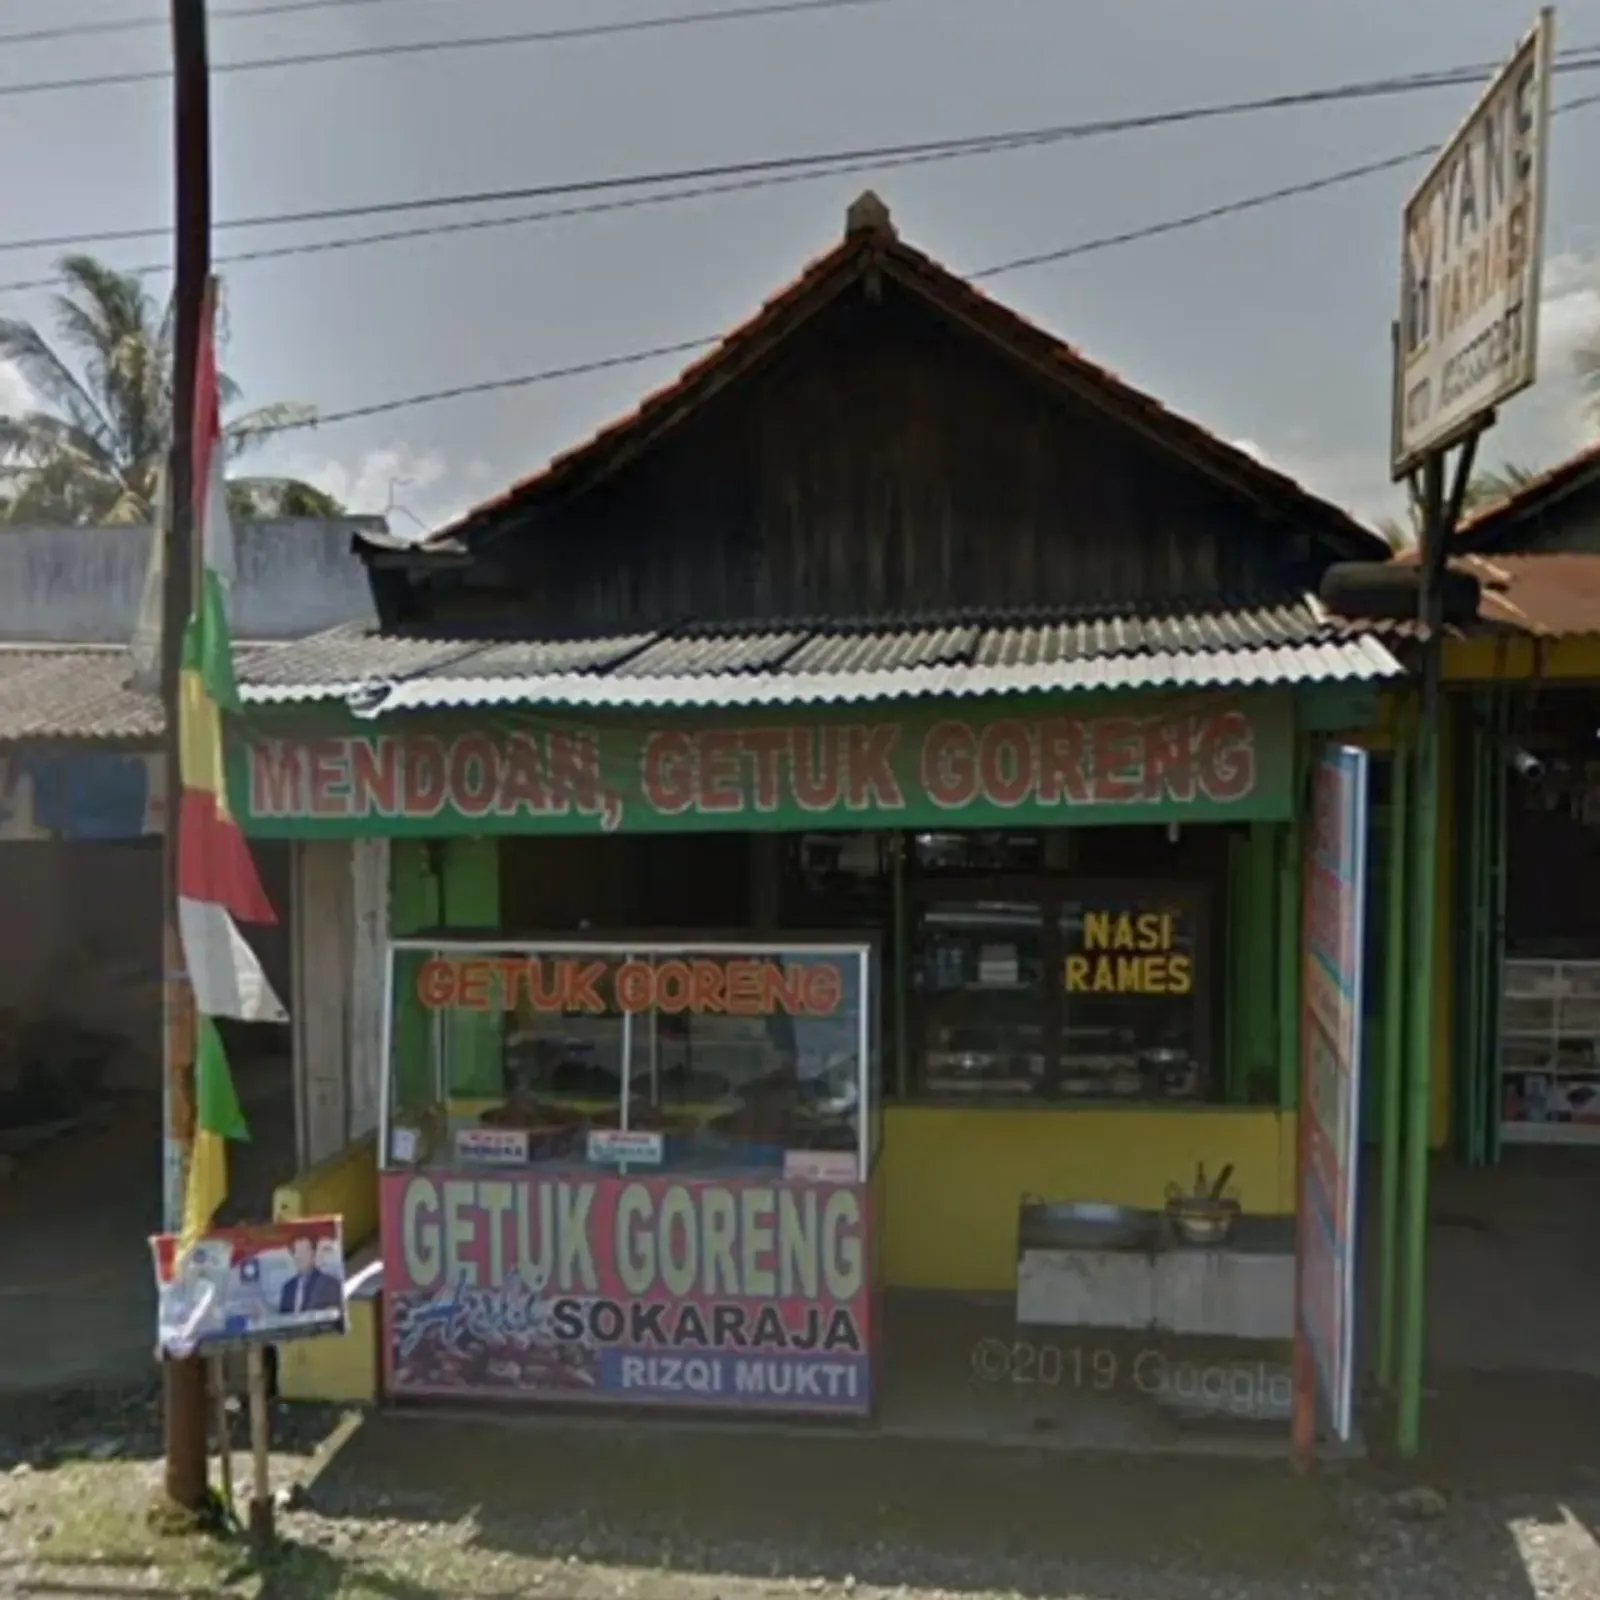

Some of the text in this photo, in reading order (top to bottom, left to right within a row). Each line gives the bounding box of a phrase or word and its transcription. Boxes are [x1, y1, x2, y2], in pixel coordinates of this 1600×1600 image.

[247, 711, 1256, 831] MENDOAN, GETUK GORENG
[1084, 912, 1172, 951] NASI
[417, 957, 841, 1015] GETUK GORENG
[1065, 955, 1192, 994] RAMES
[403, 1176, 864, 1299] GETUK GORENG
[553, 1298, 861, 1352] SOKARAJA
[621, 1355, 858, 1398] RIZQI MUKTI
